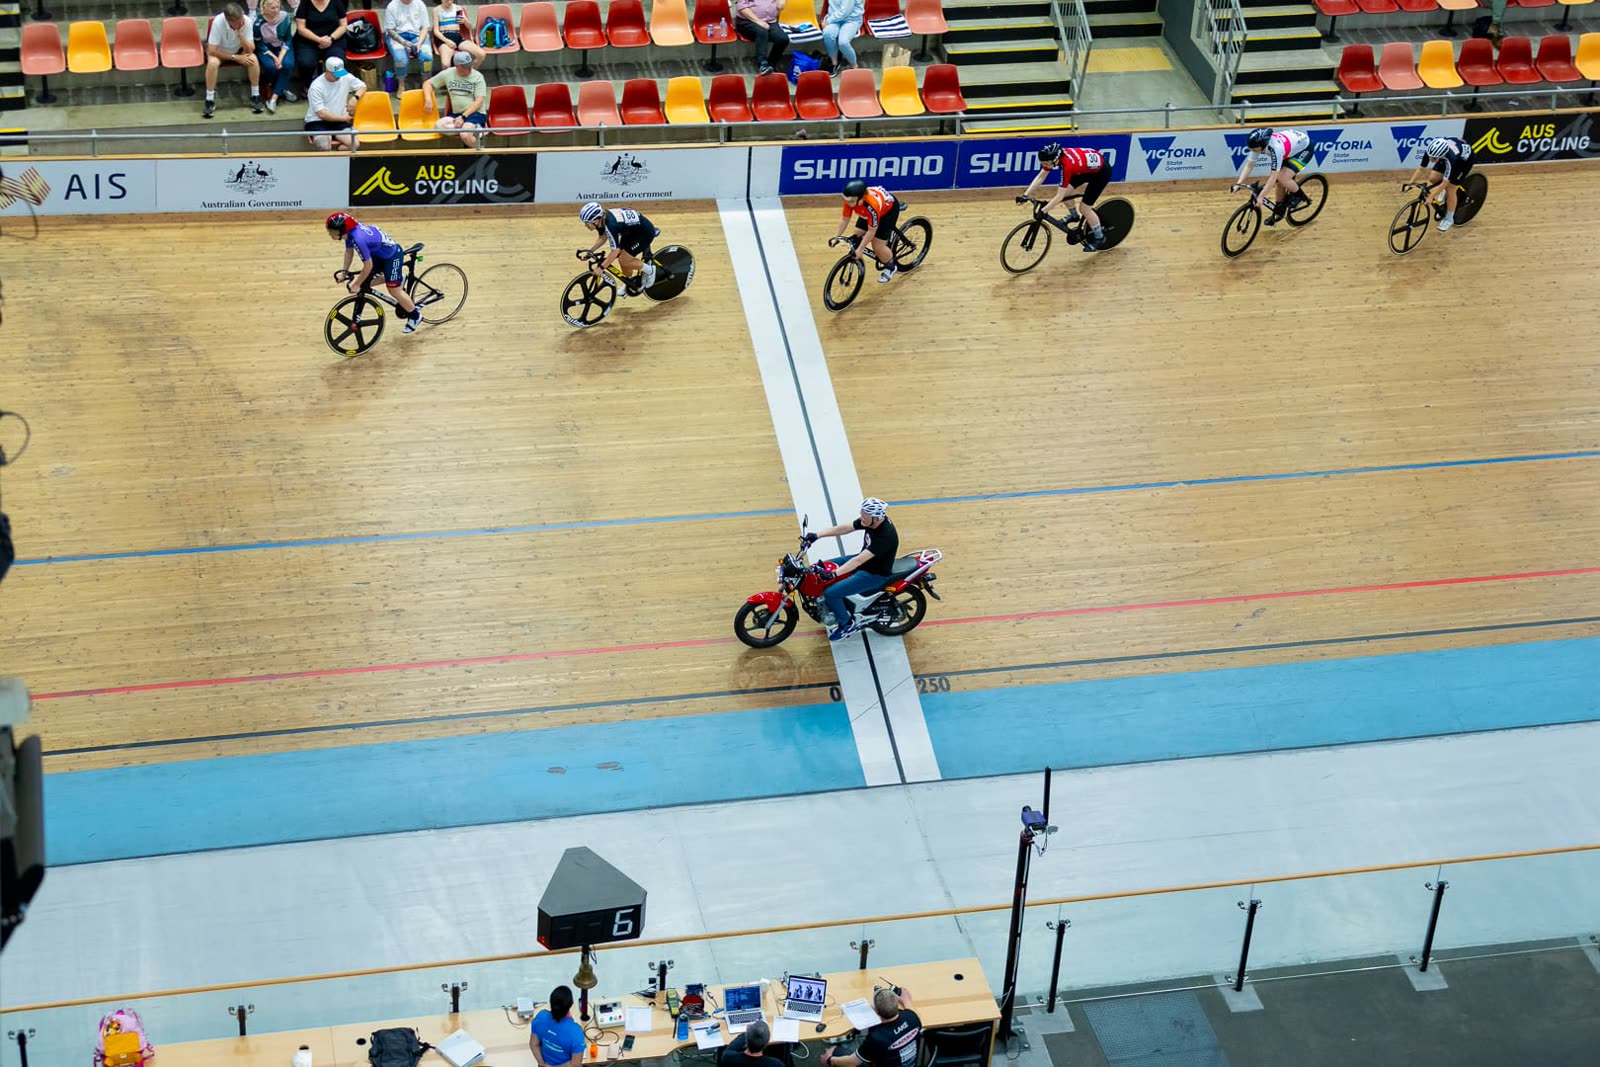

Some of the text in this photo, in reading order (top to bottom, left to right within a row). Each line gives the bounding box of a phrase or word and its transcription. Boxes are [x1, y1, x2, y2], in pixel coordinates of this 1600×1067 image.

[1520, 124, 1555, 139] AUS
[1313, 140, 1373, 152] VICTORIA
[1517, 136, 1590, 153] CYCLING
[1088, 153, 1098, 164] 30
[1144, 148, 1206, 161] VICTORIA
[415, 164, 456, 181] AUS
[793, 155, 944, 180] SHIMANO
[64, 173, 127, 200] AIS
[415, 179, 498, 195] CYCLING
[575, 190, 673, 200] Australian Government
[200, 199, 302, 209] Australian Government
[917, 677, 950, 694] 250
[829, 686, 842, 702] 0
[612, 908, 634, 937] 6
[893, 1021, 909, 1035] LAKE
